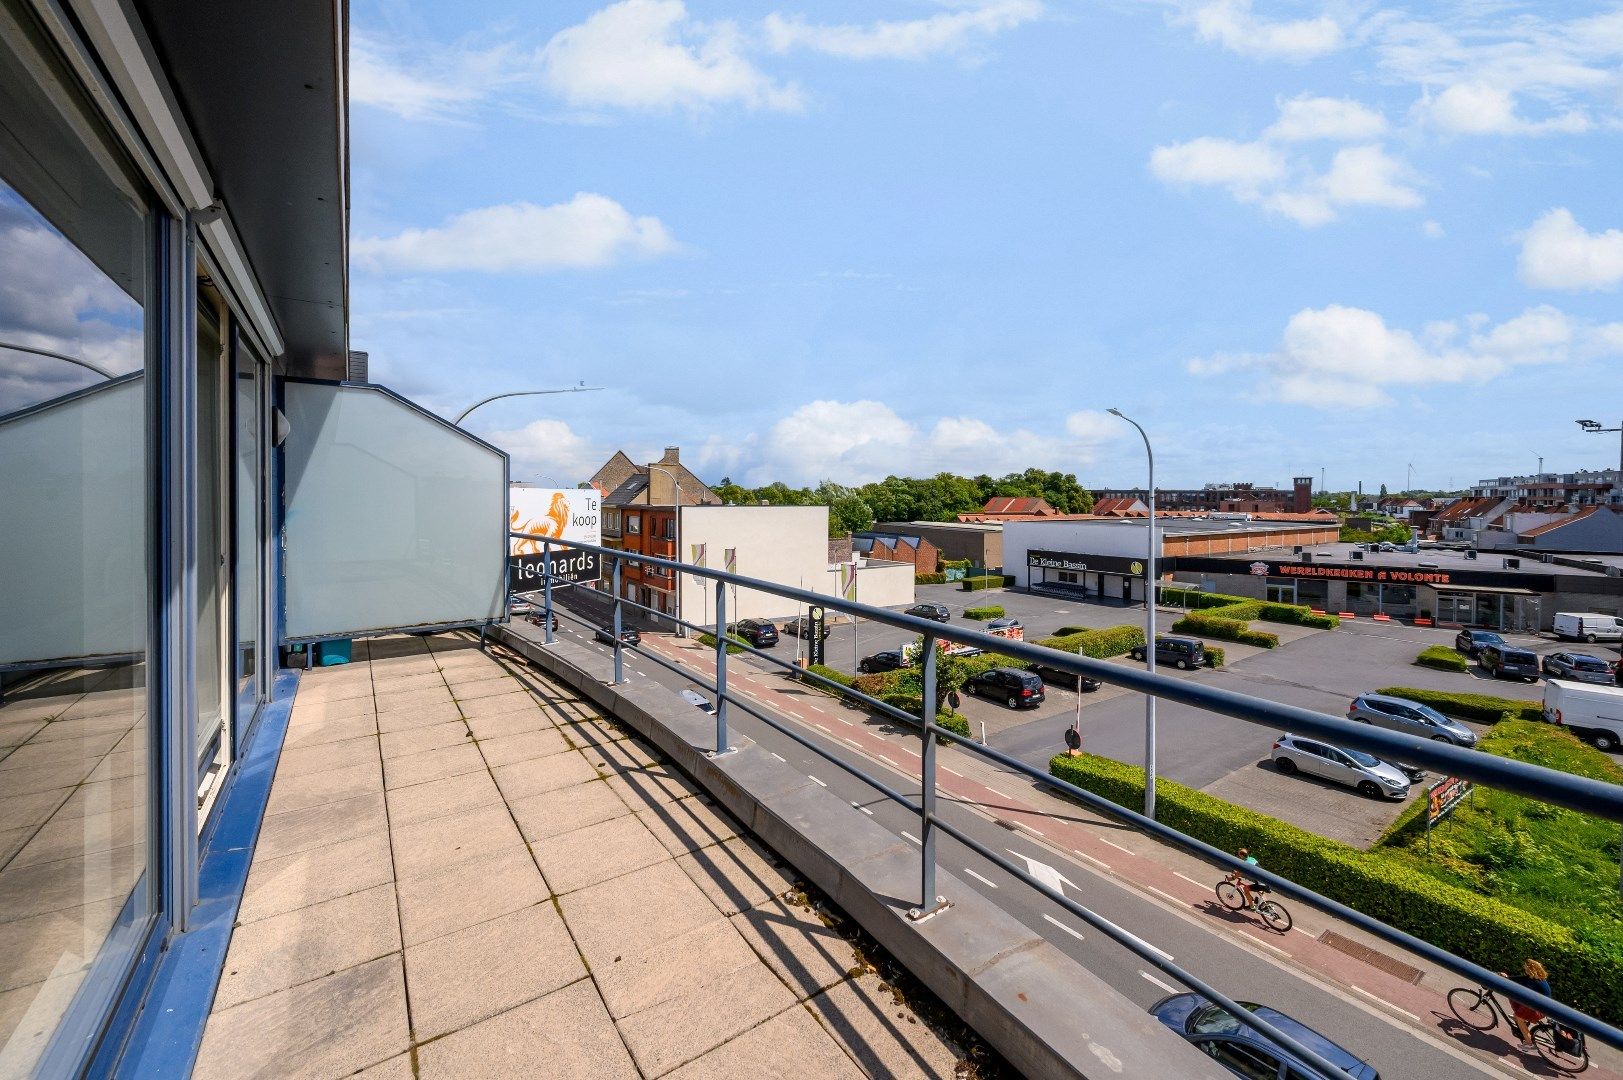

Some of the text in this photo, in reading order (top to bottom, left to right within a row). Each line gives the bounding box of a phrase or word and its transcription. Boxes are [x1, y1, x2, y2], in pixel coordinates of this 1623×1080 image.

[585, 497, 597, 511] Te
[572, 512, 597, 530] koop
[518, 551, 594, 580] leonards
[1030, 556, 1087, 570] De Kleine Bassin
